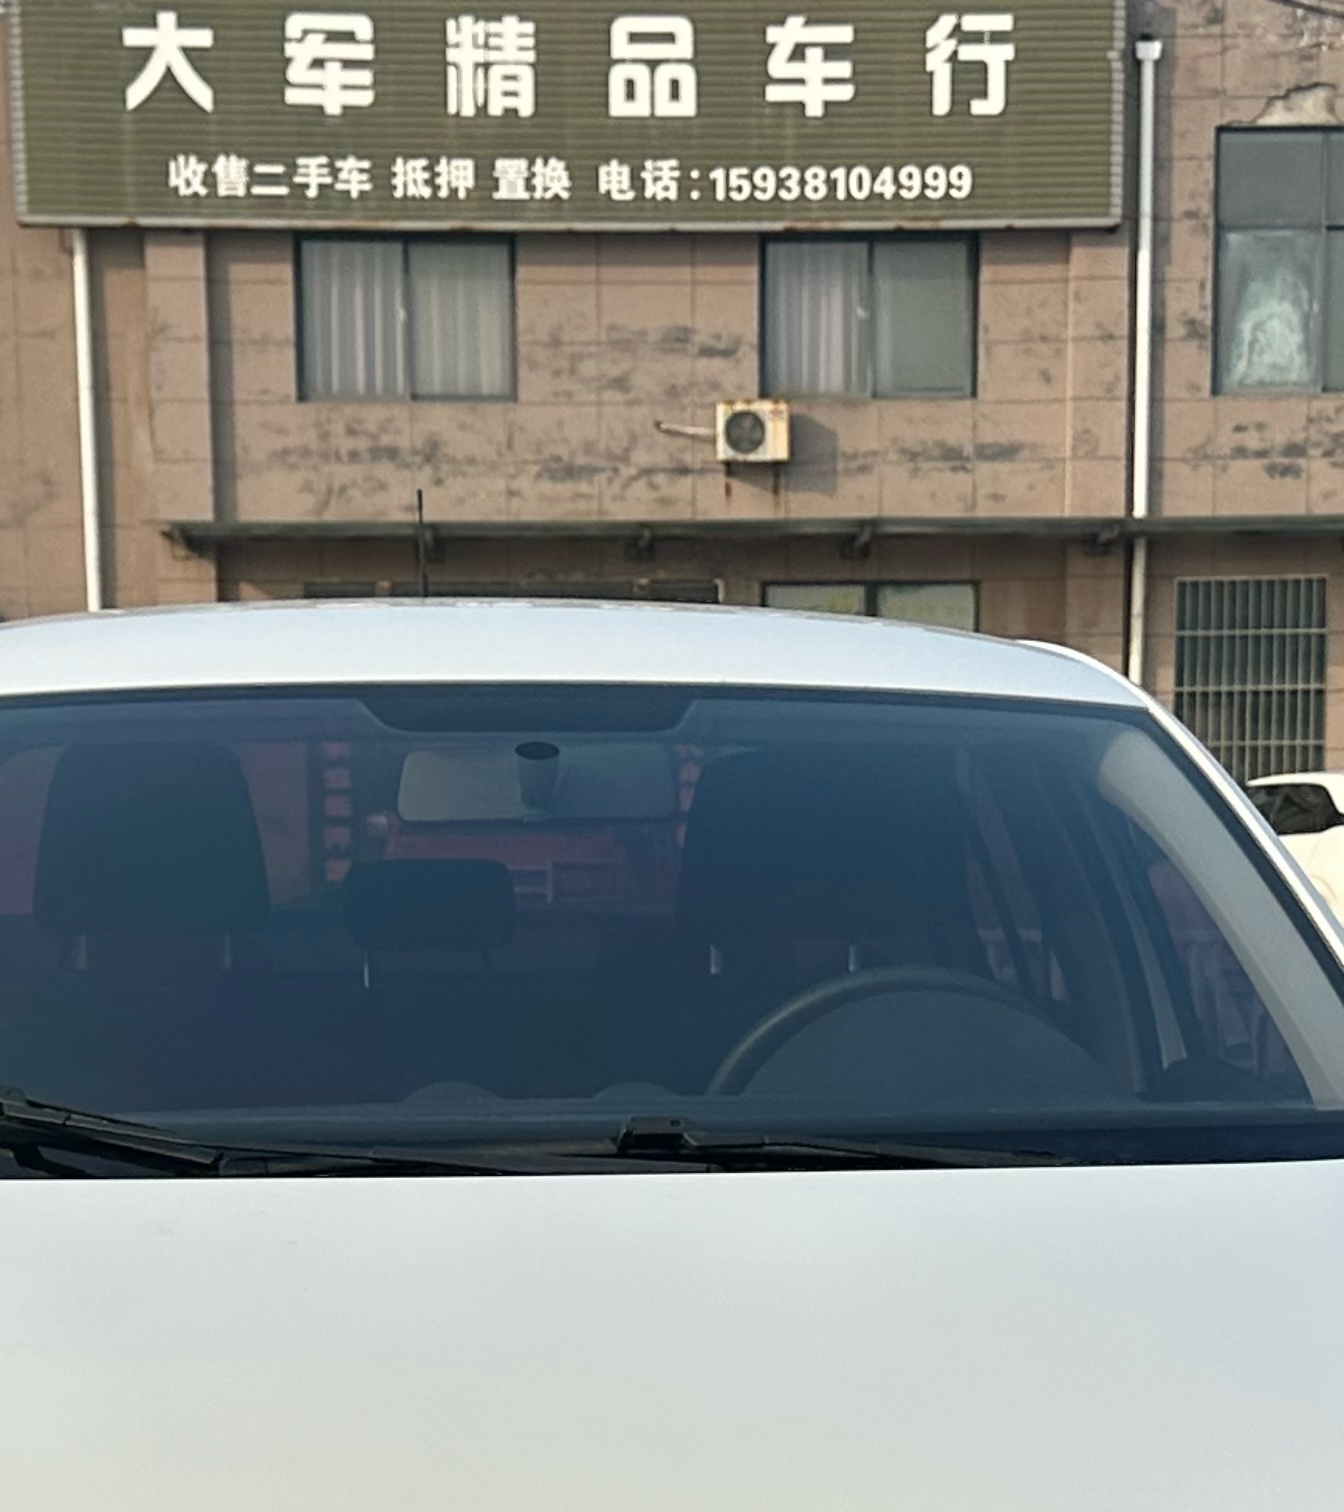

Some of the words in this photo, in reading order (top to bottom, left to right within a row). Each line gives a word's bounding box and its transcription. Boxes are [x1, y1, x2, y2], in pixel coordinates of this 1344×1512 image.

[122, 10, 1016, 118] 大军精品车行
[168, 154, 373, 199] 收售二手车
[391, 156, 476, 200] 抵押
[492, 157, 572, 200] 置换
